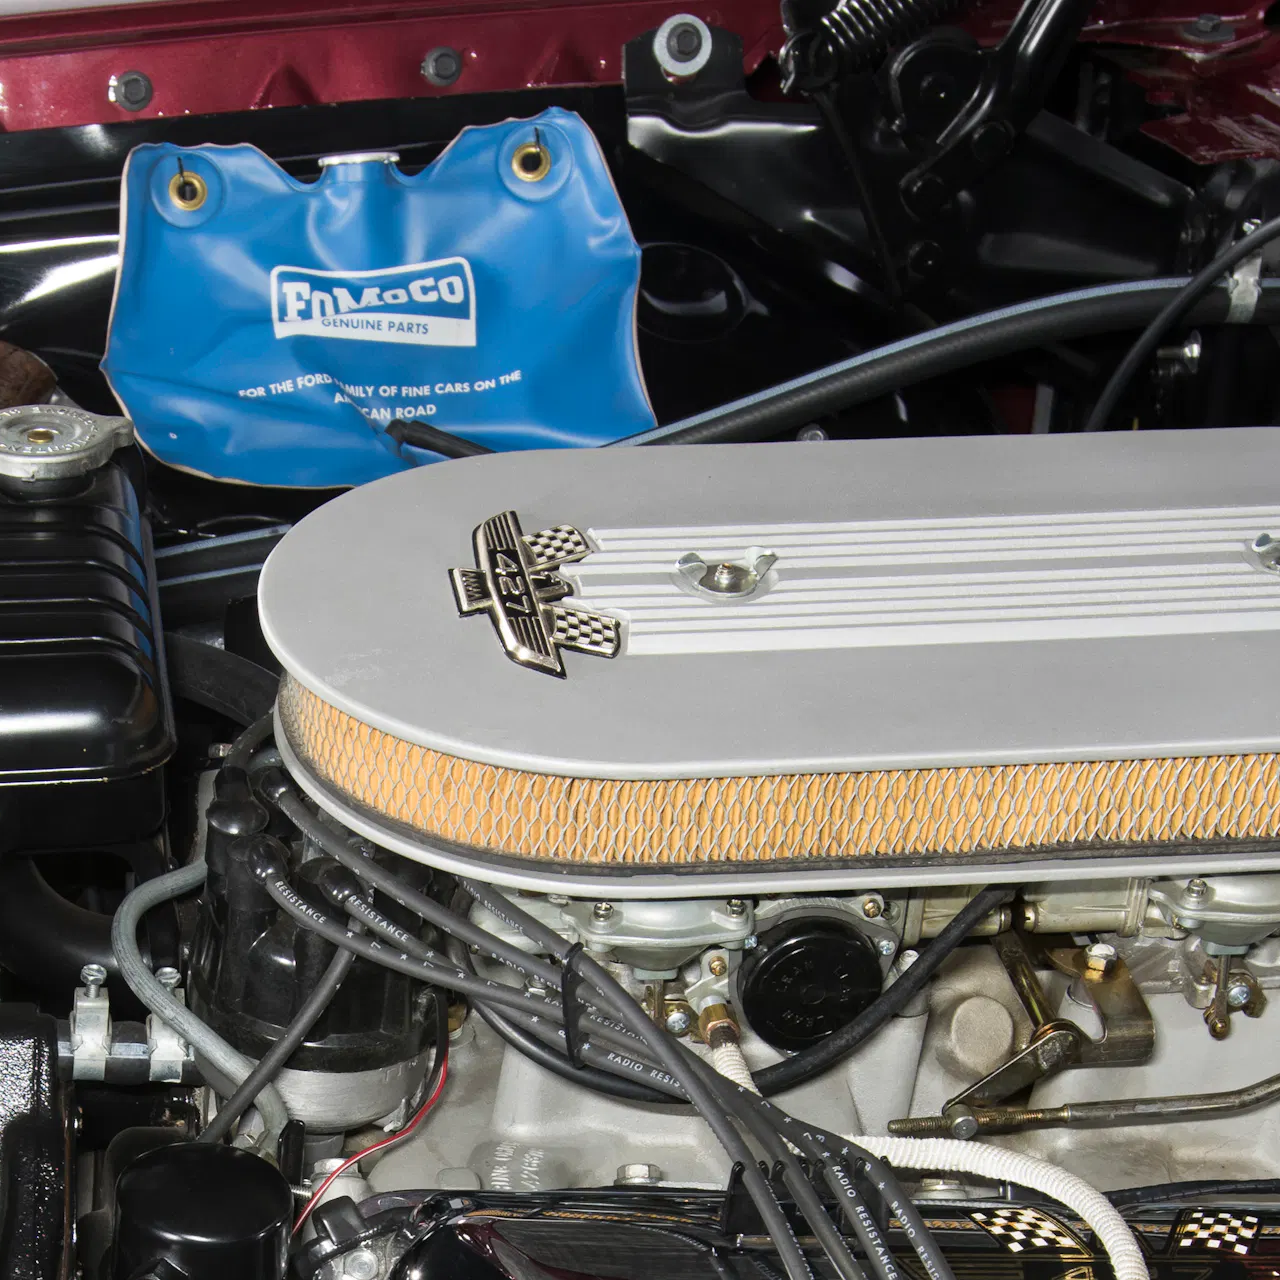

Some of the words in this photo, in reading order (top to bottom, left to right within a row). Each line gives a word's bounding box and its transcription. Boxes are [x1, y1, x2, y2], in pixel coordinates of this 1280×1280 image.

[321, 317, 383, 331] GENUINE
[388, 321, 429, 335] PARTS
[239, 387, 266, 398] FOR
[270, 380, 294, 395] THE
[297, 373, 332, 388] FORD
[379, 385, 398, 397] OF
[401, 385, 430, 398] FINE
[435, 382, 470, 395] CARS
[474, 379, 496, 392] ON
[499, 370, 522, 386] THE
[396, 404, 437, 419] ROAD
[274, 880, 327, 924] RESISTANCE
[348, 894, 409, 942] RESISTANCE
[607, 1052, 643, 1072] RADIO
[832, 1165, 856, 1198] RADIO
[855, 1206, 897, 1280] RESISTANCE
[890, 1201, 916, 1238] RADIO
